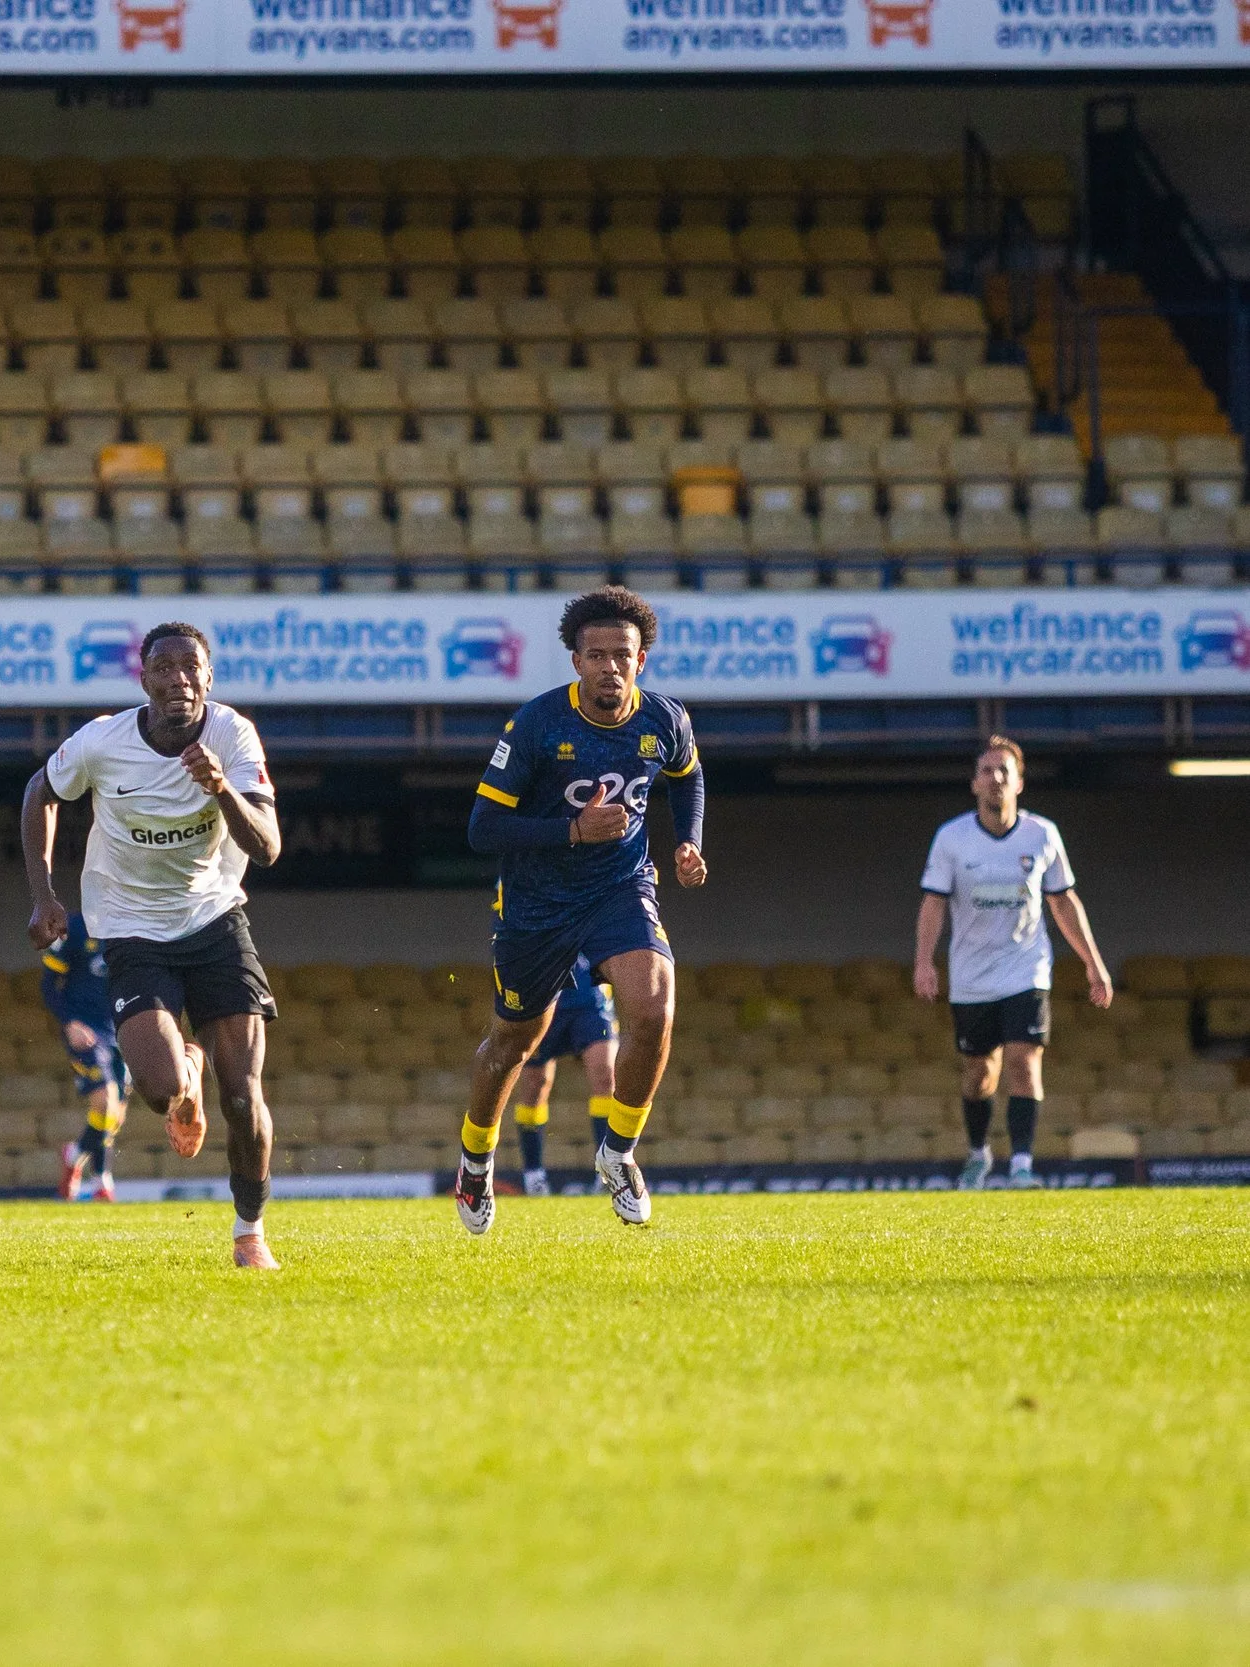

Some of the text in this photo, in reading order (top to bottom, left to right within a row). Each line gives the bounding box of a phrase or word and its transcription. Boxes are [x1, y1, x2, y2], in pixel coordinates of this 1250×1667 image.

[250, 28, 474, 59] anyvans.com
[624, 25, 847, 58] anyvans.com
[996, 23, 1217, 54] anyvans.com
[212, 608, 427, 648] wefinance
[952, 601, 1161, 641] wefinance
[214, 656, 429, 690] anycar.com
[952, 648, 1164, 681] anycar.com
[131, 819, 217, 845] Glencar
